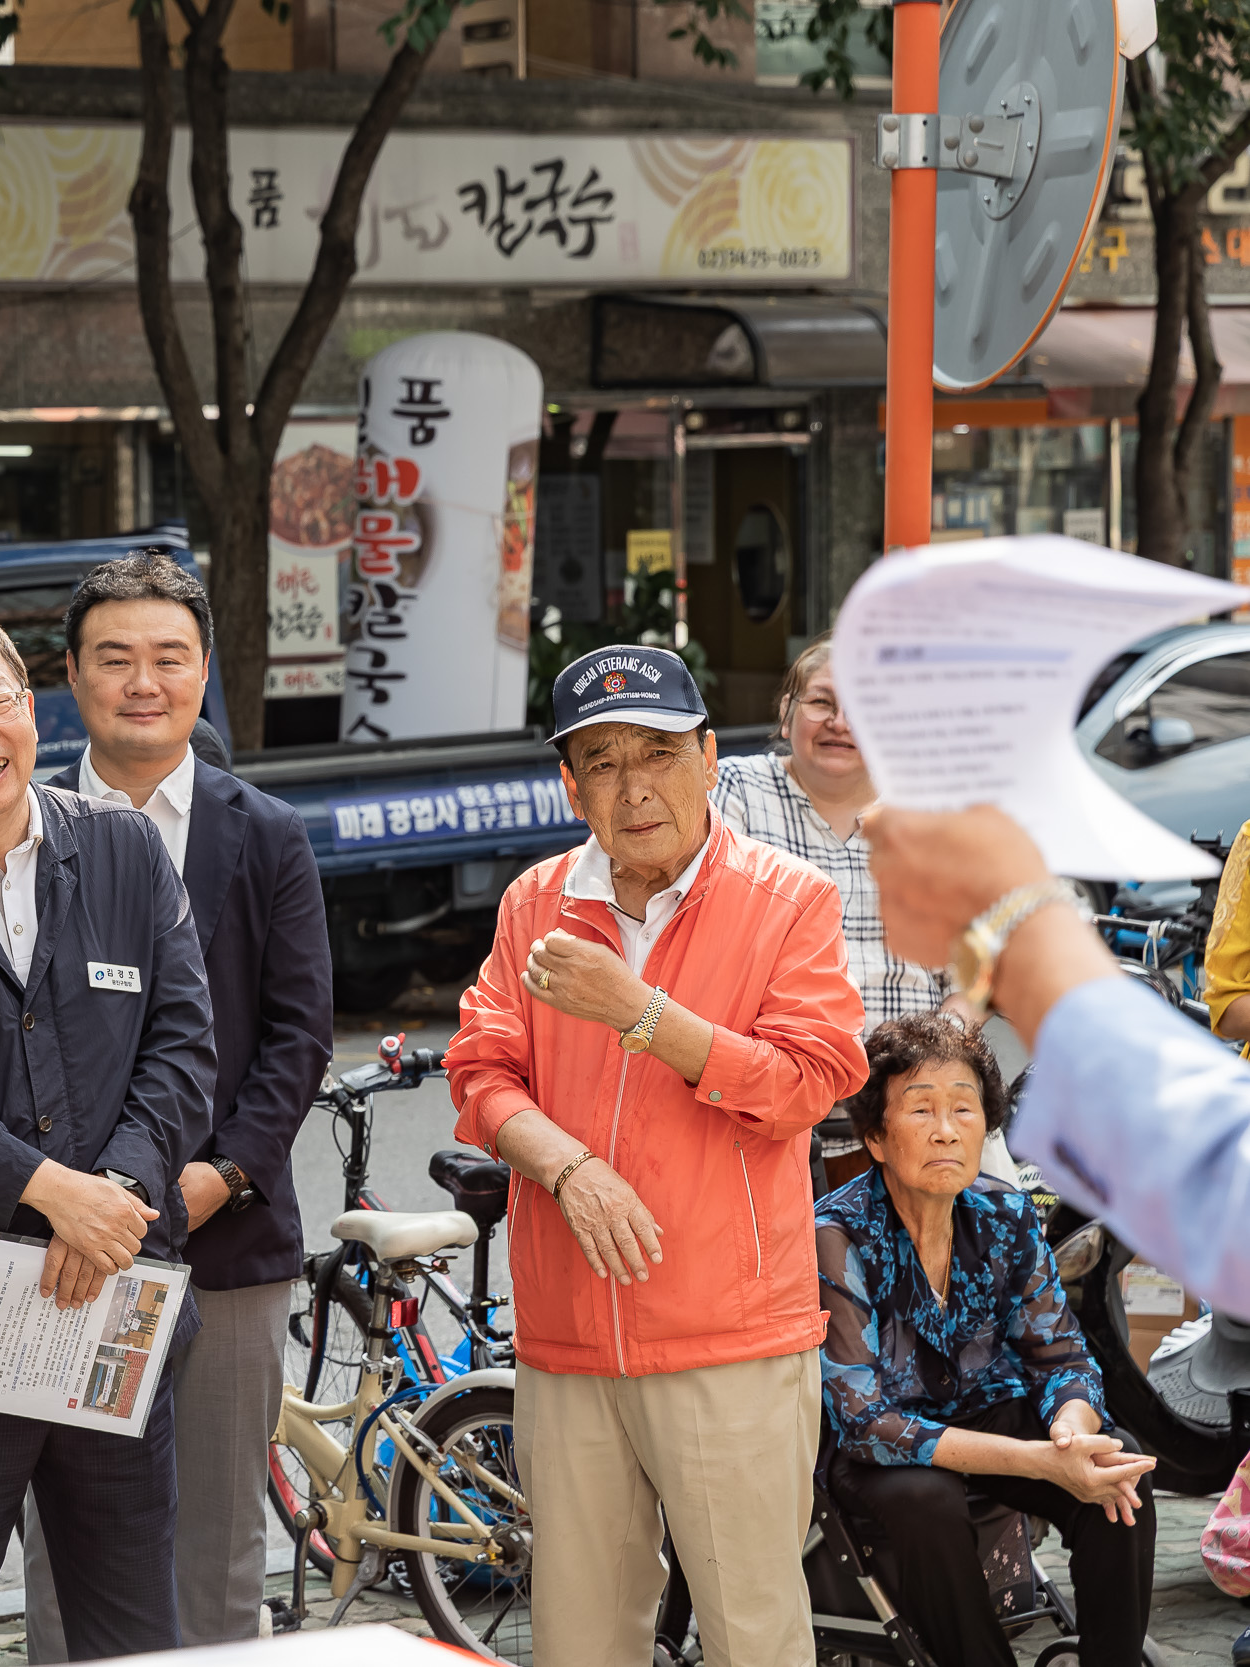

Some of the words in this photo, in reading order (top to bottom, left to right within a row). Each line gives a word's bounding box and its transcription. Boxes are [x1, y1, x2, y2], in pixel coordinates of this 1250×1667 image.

[456, 156, 616, 258] 칼국수
[572, 666, 600, 697] KOREAN
[595, 656, 641, 675] VETERANS
[638, 662, 663, 684] ASSN
[335, 802, 386, 841] 미래
[385, 794, 459, 836] 공업사
